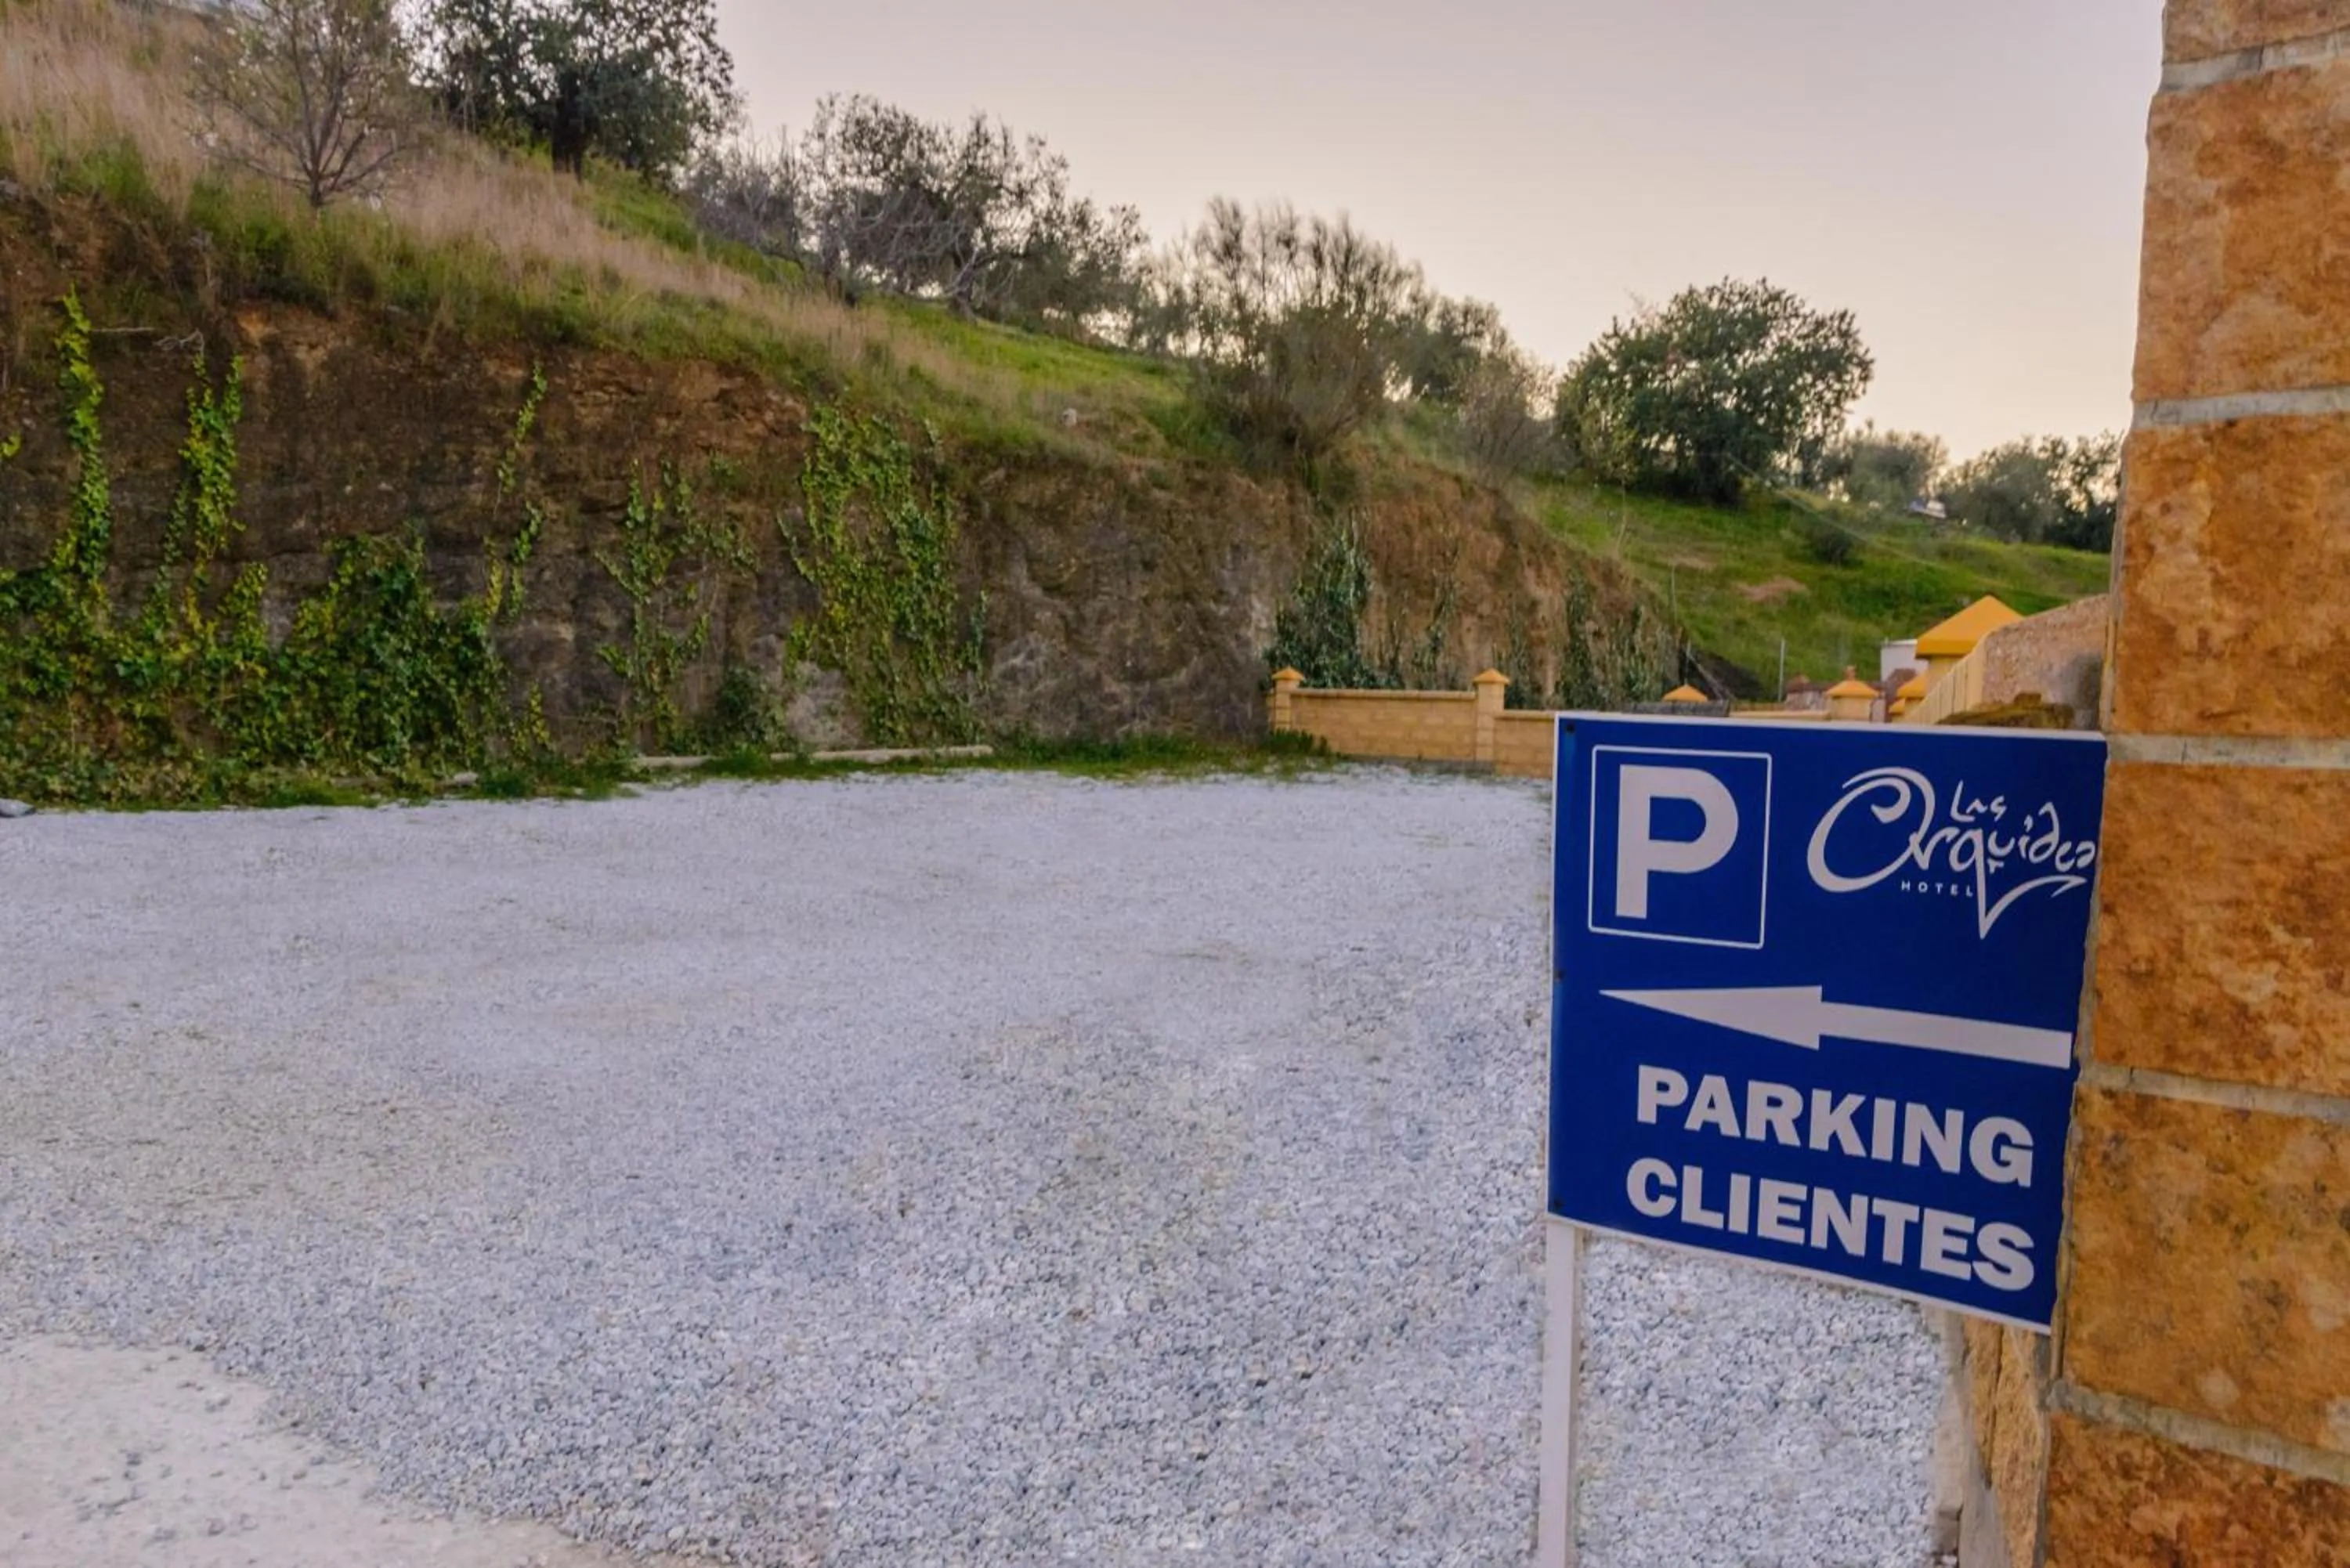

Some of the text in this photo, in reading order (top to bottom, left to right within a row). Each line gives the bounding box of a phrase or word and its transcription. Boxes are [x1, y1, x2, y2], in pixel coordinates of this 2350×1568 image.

[1615, 764, 1738, 919] P
[1807, 767, 2096, 938] Orquidea
[1950, 780, 2007, 822] Las
[1900, 880, 1974, 897] HOTEL
[1637, 1064, 2034, 1187] PARKING
[1626, 1158, 2035, 1291] CLIENTES
